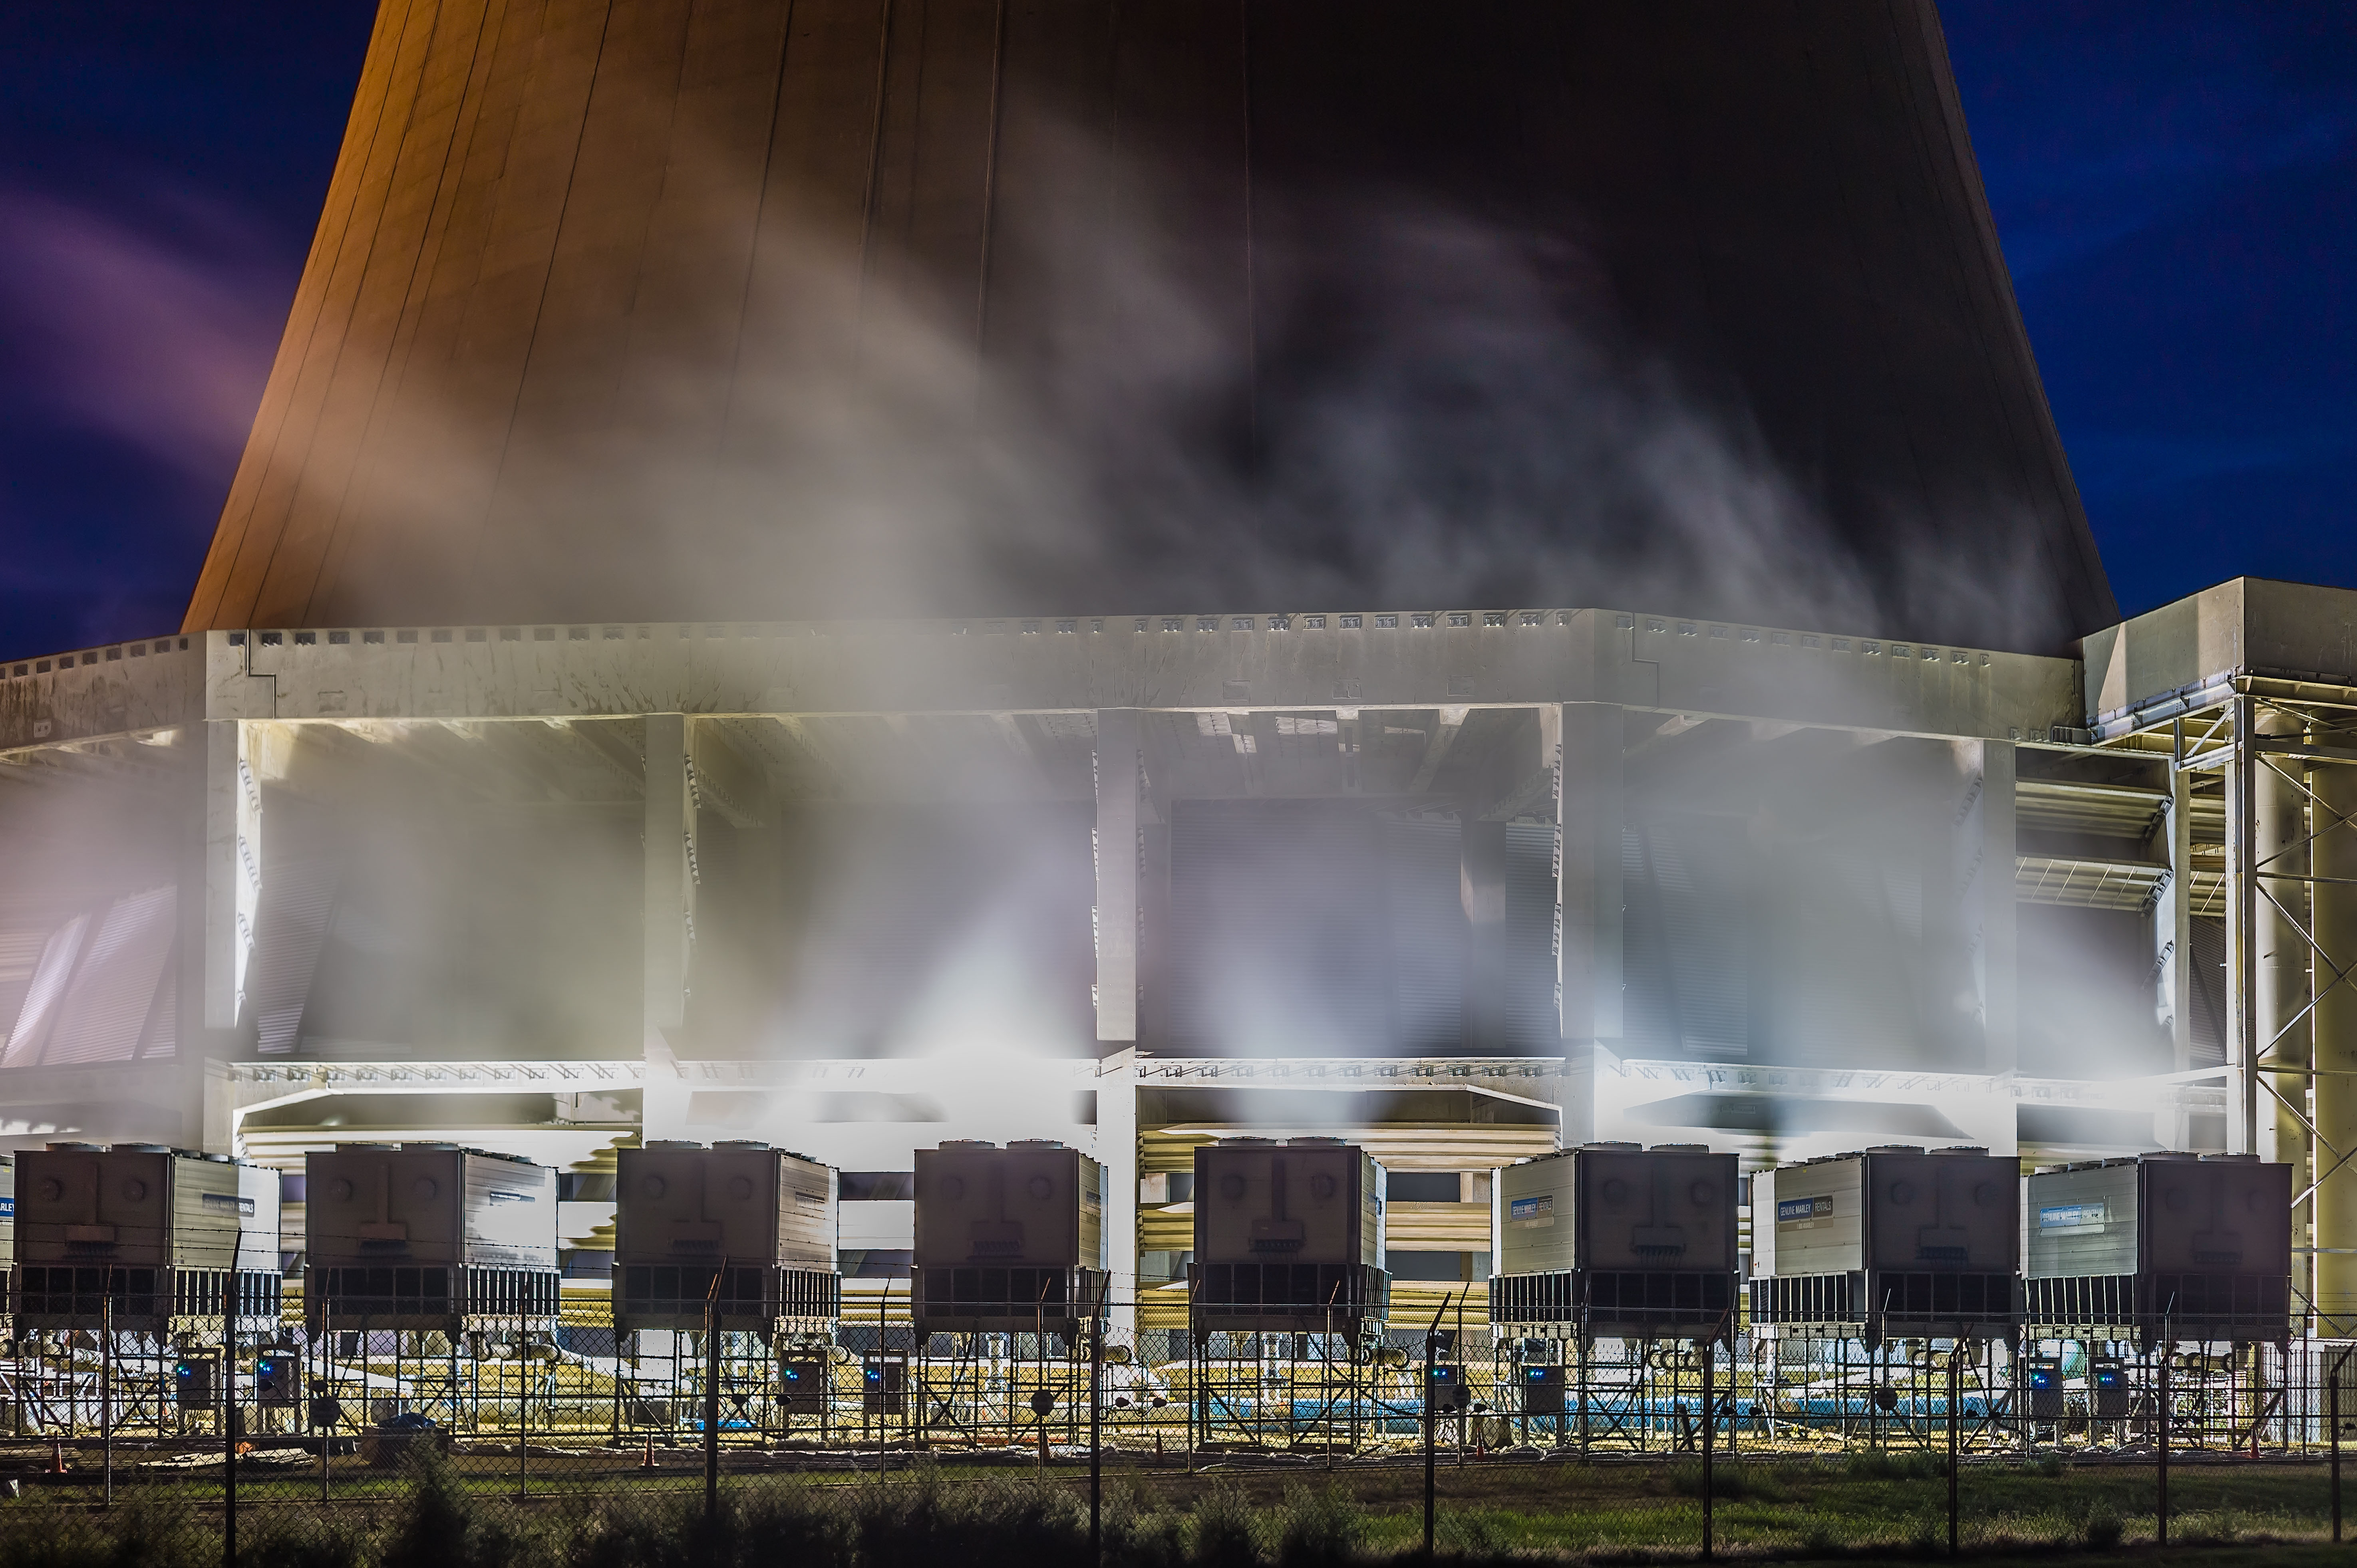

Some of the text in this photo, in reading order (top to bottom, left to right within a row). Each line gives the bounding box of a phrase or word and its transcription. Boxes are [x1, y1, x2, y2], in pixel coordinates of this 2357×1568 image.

[1539, 1201, 1552, 1211] RENTALS
[1780, 1201, 1831, 1216] GENUINE MARLEY RENTALS
